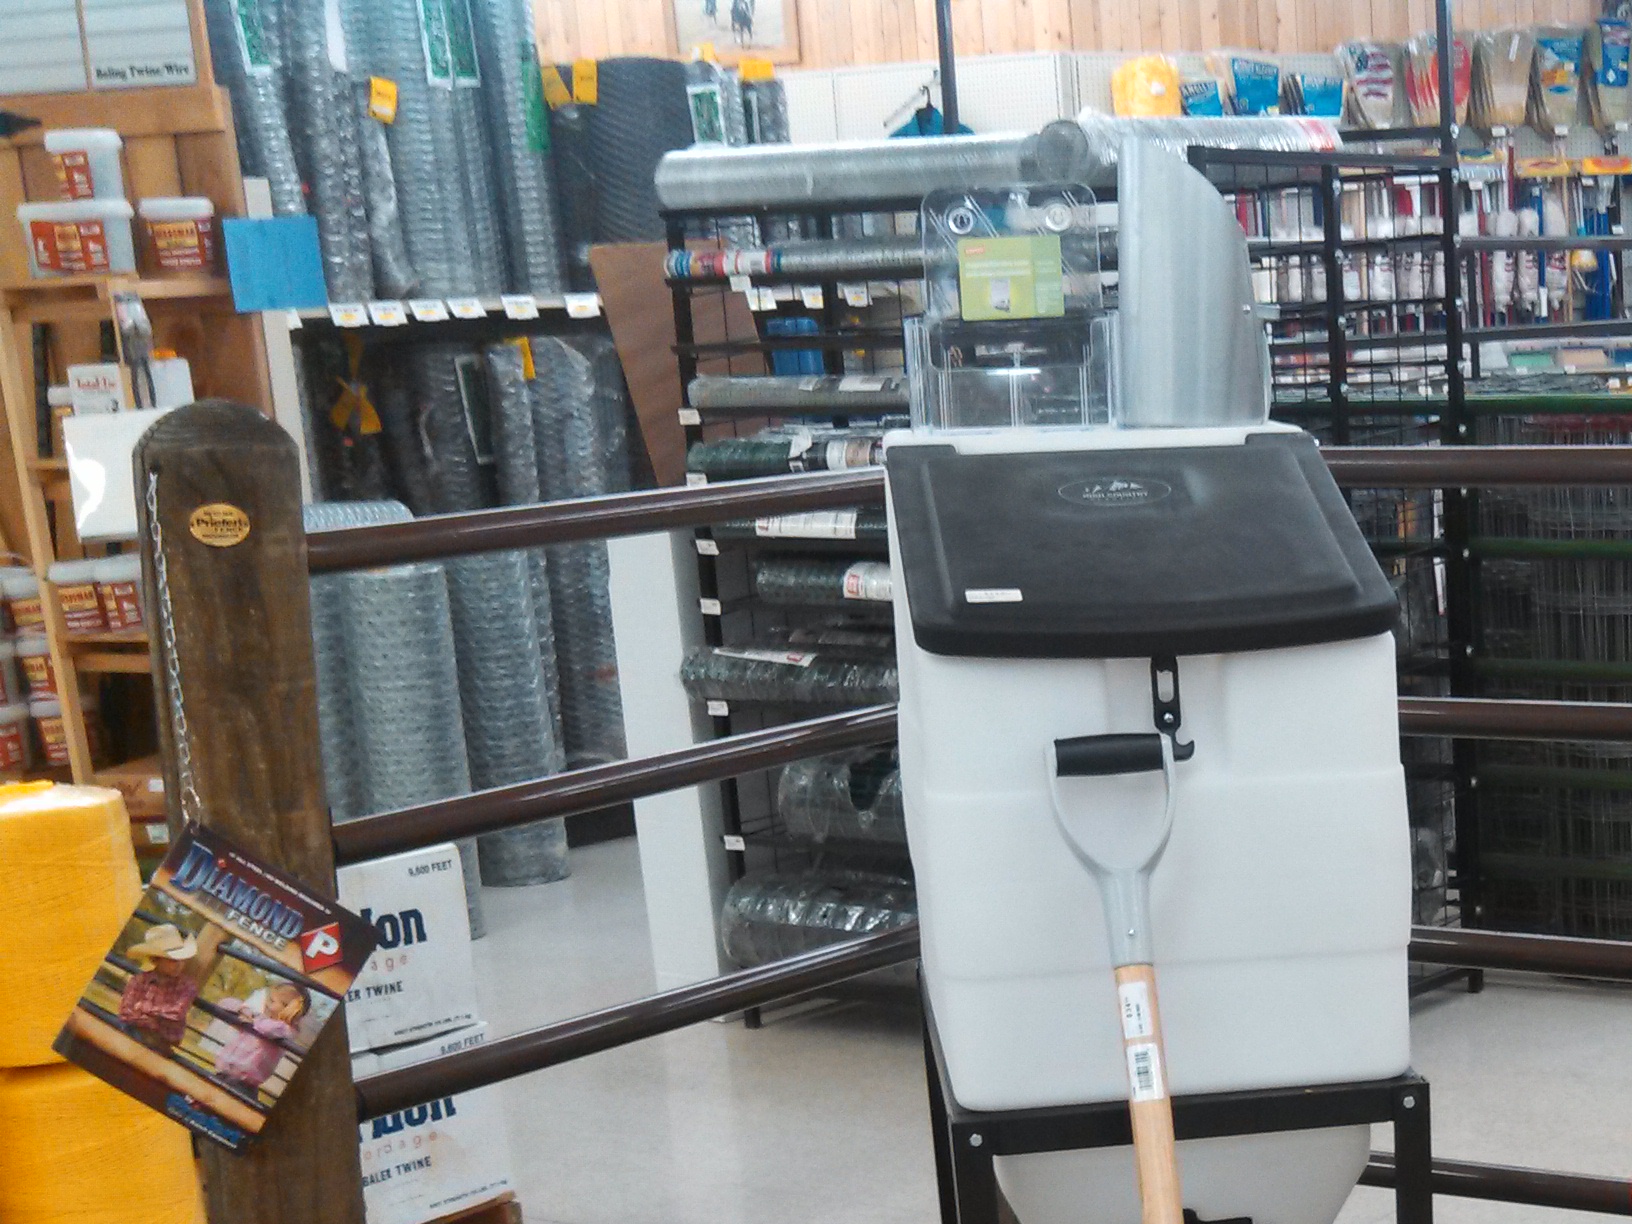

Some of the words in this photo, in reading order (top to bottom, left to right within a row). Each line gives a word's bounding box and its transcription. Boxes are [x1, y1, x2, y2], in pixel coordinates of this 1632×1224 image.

[431, 859, 453, 872] FEET
[169, 840, 306, 940] DIAMOND
[224, 908, 289, 951] FENCE
[304, 929, 339, 960] P
[365, 980, 404, 999] TWINE
[464, 1032, 486, 1047] FEET
[395, 1155, 432, 1177] TWINE
